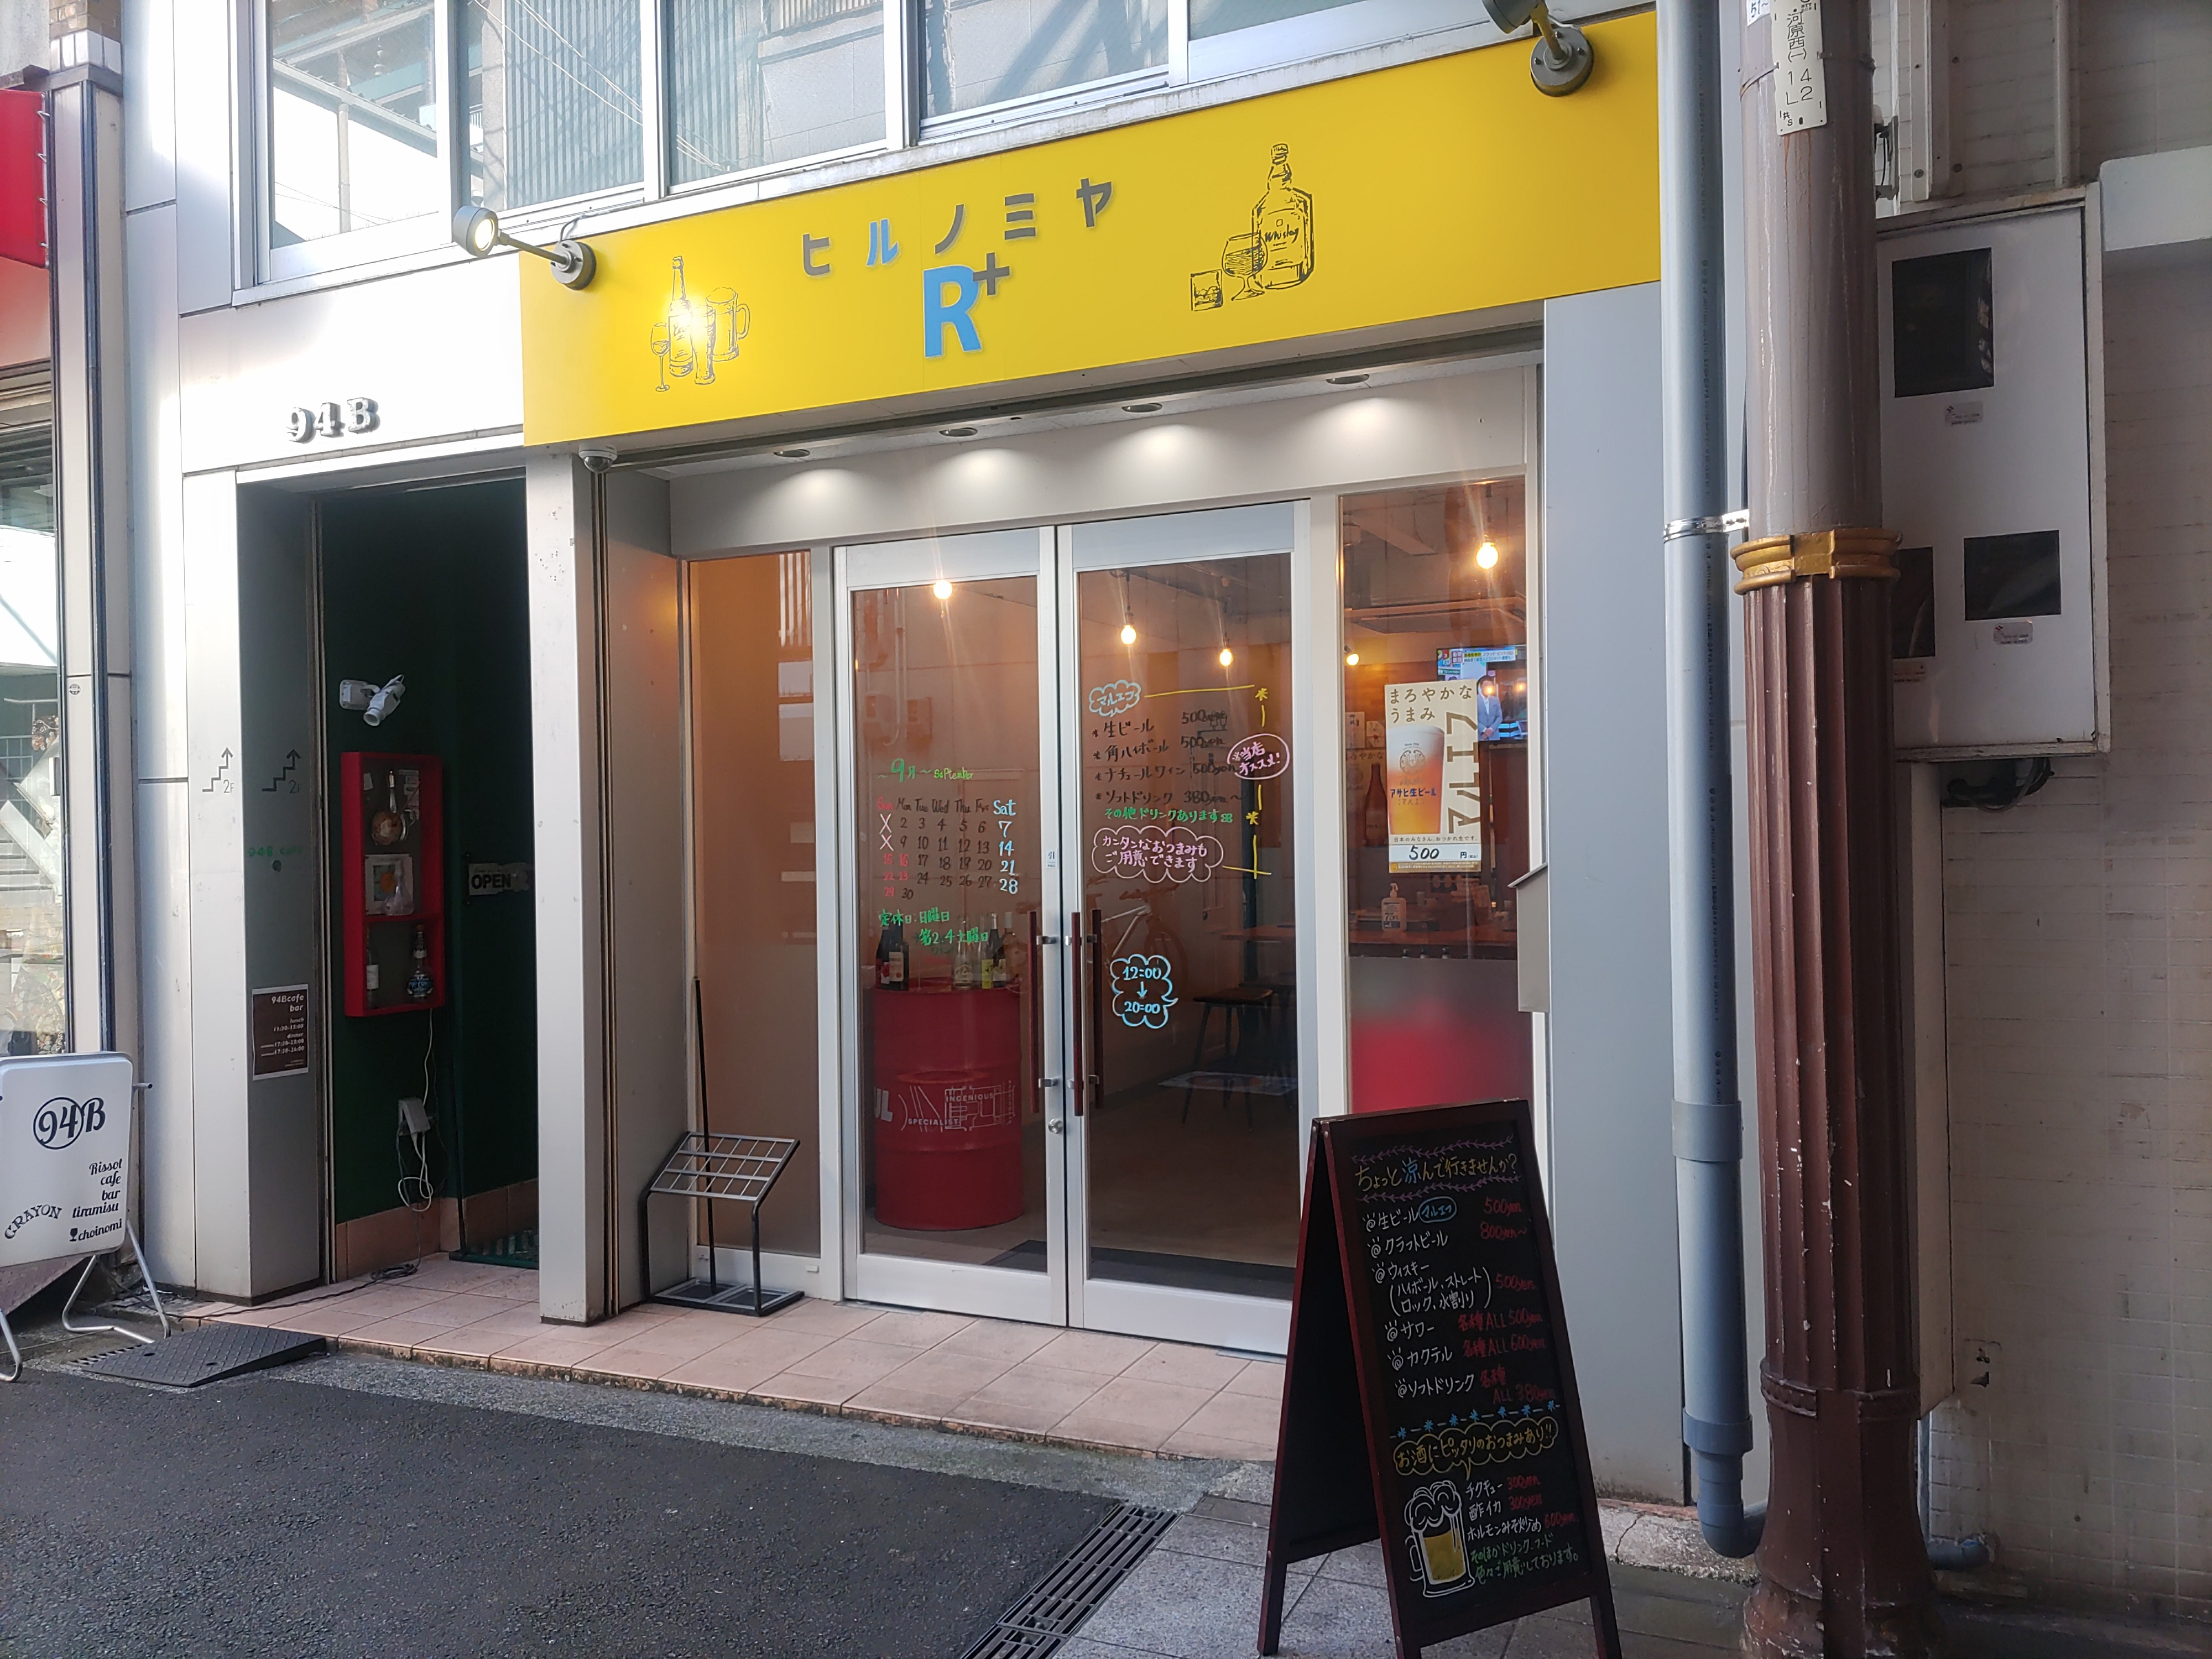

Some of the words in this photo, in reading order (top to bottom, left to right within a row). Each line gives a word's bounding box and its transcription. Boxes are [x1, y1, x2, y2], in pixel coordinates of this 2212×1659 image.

[801, 176, 1113, 277] ヒルノミヤ
[285, 397, 380, 444] 94B
[1390, 685, 1472, 704] まろやかな
[1391, 707, 1435, 723] うまみ
[1105, 739, 1168, 762] 角ハイボール
[1345, 752, 1384, 761] ろやかな
[223, 779, 234, 794] 2F
[1390, 787, 1437, 798] アサヒ生ビール
[1106, 790, 1173, 805] ソフトドリンク
[877, 796, 894, 810] Sun
[896, 797, 911, 811] Mon
[915, 798, 928, 812] Tue
[931, 798, 948, 813] Wed
[954, 799, 971, 813] Thu
[975, 798, 989, 813] Fri
[993, 799, 1016, 816] Sat
[900, 817, 907, 828] 2
[919, 817, 925, 829] 3
[937, 818, 947, 832] 4
[959, 818, 968, 832] 5
[978, 821, 986, 833] 6
[998, 821, 1013, 838] 7
[900, 835, 907, 848] 9
[917, 836, 928, 849] 10
[938, 836, 948, 852] 11
[958, 838, 971, 853] 12
[977, 840, 989, 854] 13
[999, 840, 1015, 857] 14
[1102, 836, 1208, 857] カンタンなおつまみも
[1409, 844, 1439, 860] 500
[1048, 851, 1055, 859] 引
[1105, 849, 1198, 873] ご用意できます
[883, 853, 893, 865] 15
[899, 853, 909, 867] 16
[917, 853, 928, 867] 17
[939, 856, 951, 870] 18
[959, 857, 971, 870] 19
[978, 859, 992, 871] 20
[999, 859, 1015, 876] 21
[471, 874, 512, 889] OPEN
[883, 871, 895, 880] 22
[899, 870, 909, 880] 23
[917, 872, 928, 885] 24
[940, 875, 952, 888] 25
[959, 873, 972, 887] 26
[978, 875, 993, 889] 27
[999, 878, 1019, 895] 28
[884, 886, 895, 898] 29
[901, 888, 914, 900] 30
[1122, 966, 1162, 980] 12:00
[271, 994, 304, 1004] 94Bcafe
[1124, 1001, 1161, 1014] 20:00
[946, 1092, 994, 1102] INGENIOUS
[38, 1097, 106, 1146] 94B
[907, 1118, 959, 1126] SPECIALIST
[100, 1171, 121, 1187] cafe
[101, 1189, 121, 1200] bar
[72, 1202, 119, 1218] tiramisu
[4, 1203, 62, 1240] CRAYON
[78, 1219, 123, 1241] choinomi
[1467, 1516, 1542, 1541] ホルモンみそ炒め
